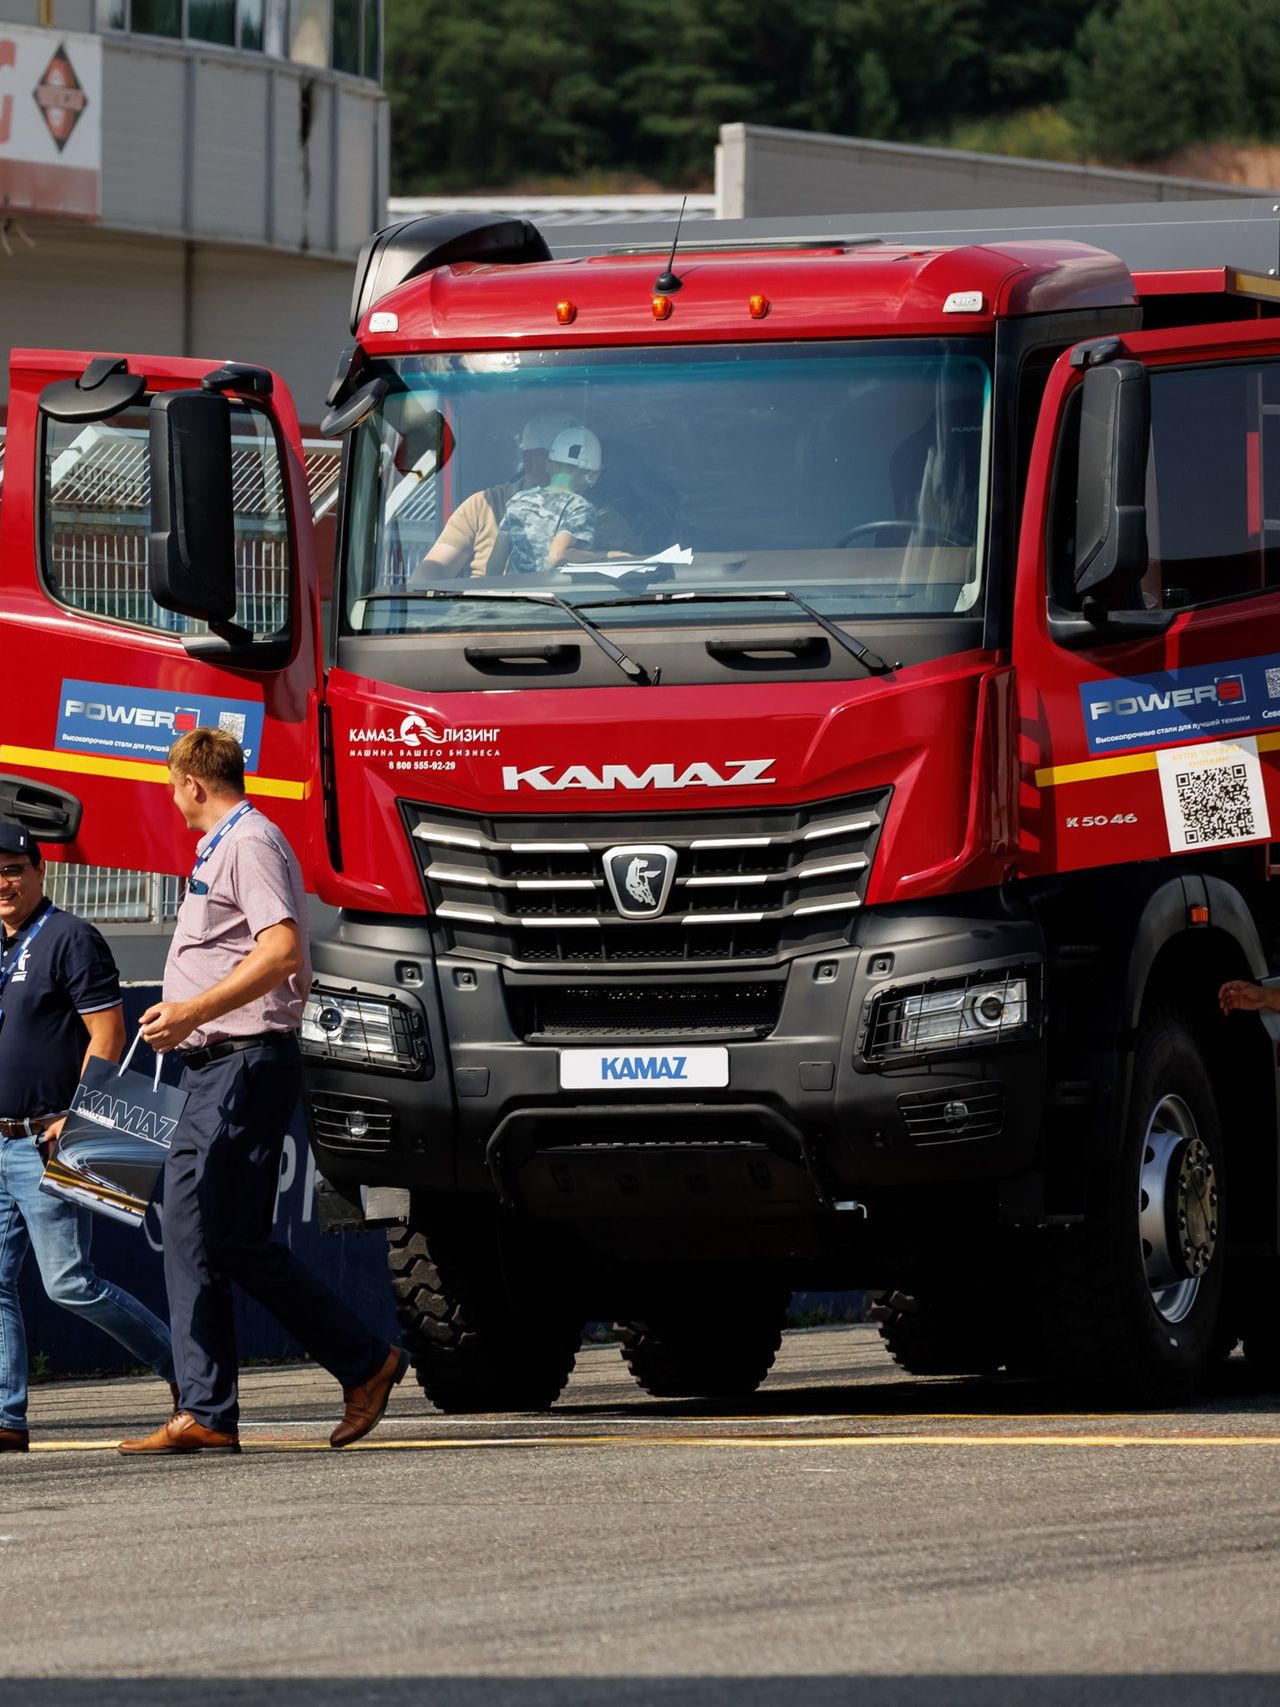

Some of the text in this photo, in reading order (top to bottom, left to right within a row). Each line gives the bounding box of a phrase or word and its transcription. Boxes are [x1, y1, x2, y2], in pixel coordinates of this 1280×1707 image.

[1090, 681, 1242, 720] POWERS
[65, 700, 196, 732] POWERS
[1095, 713, 1250, 745] Высокопрочные стали для лучшей техники
[62, 733, 169, 753] Высокопрочные стали для лучшей
[349, 728, 500, 742] КАМАЗ ЛИЗИНГ
[350, 749, 500, 757] МАШИНА ВАШЕГО БИЗНЕСА
[388, 761, 456, 770] 8 800 555-92-29
[502, 759, 777, 791] KAMAZ
[601, 1056, 688, 1080] KAMAZ
[69, 1083, 179, 1149] KAMAZ
